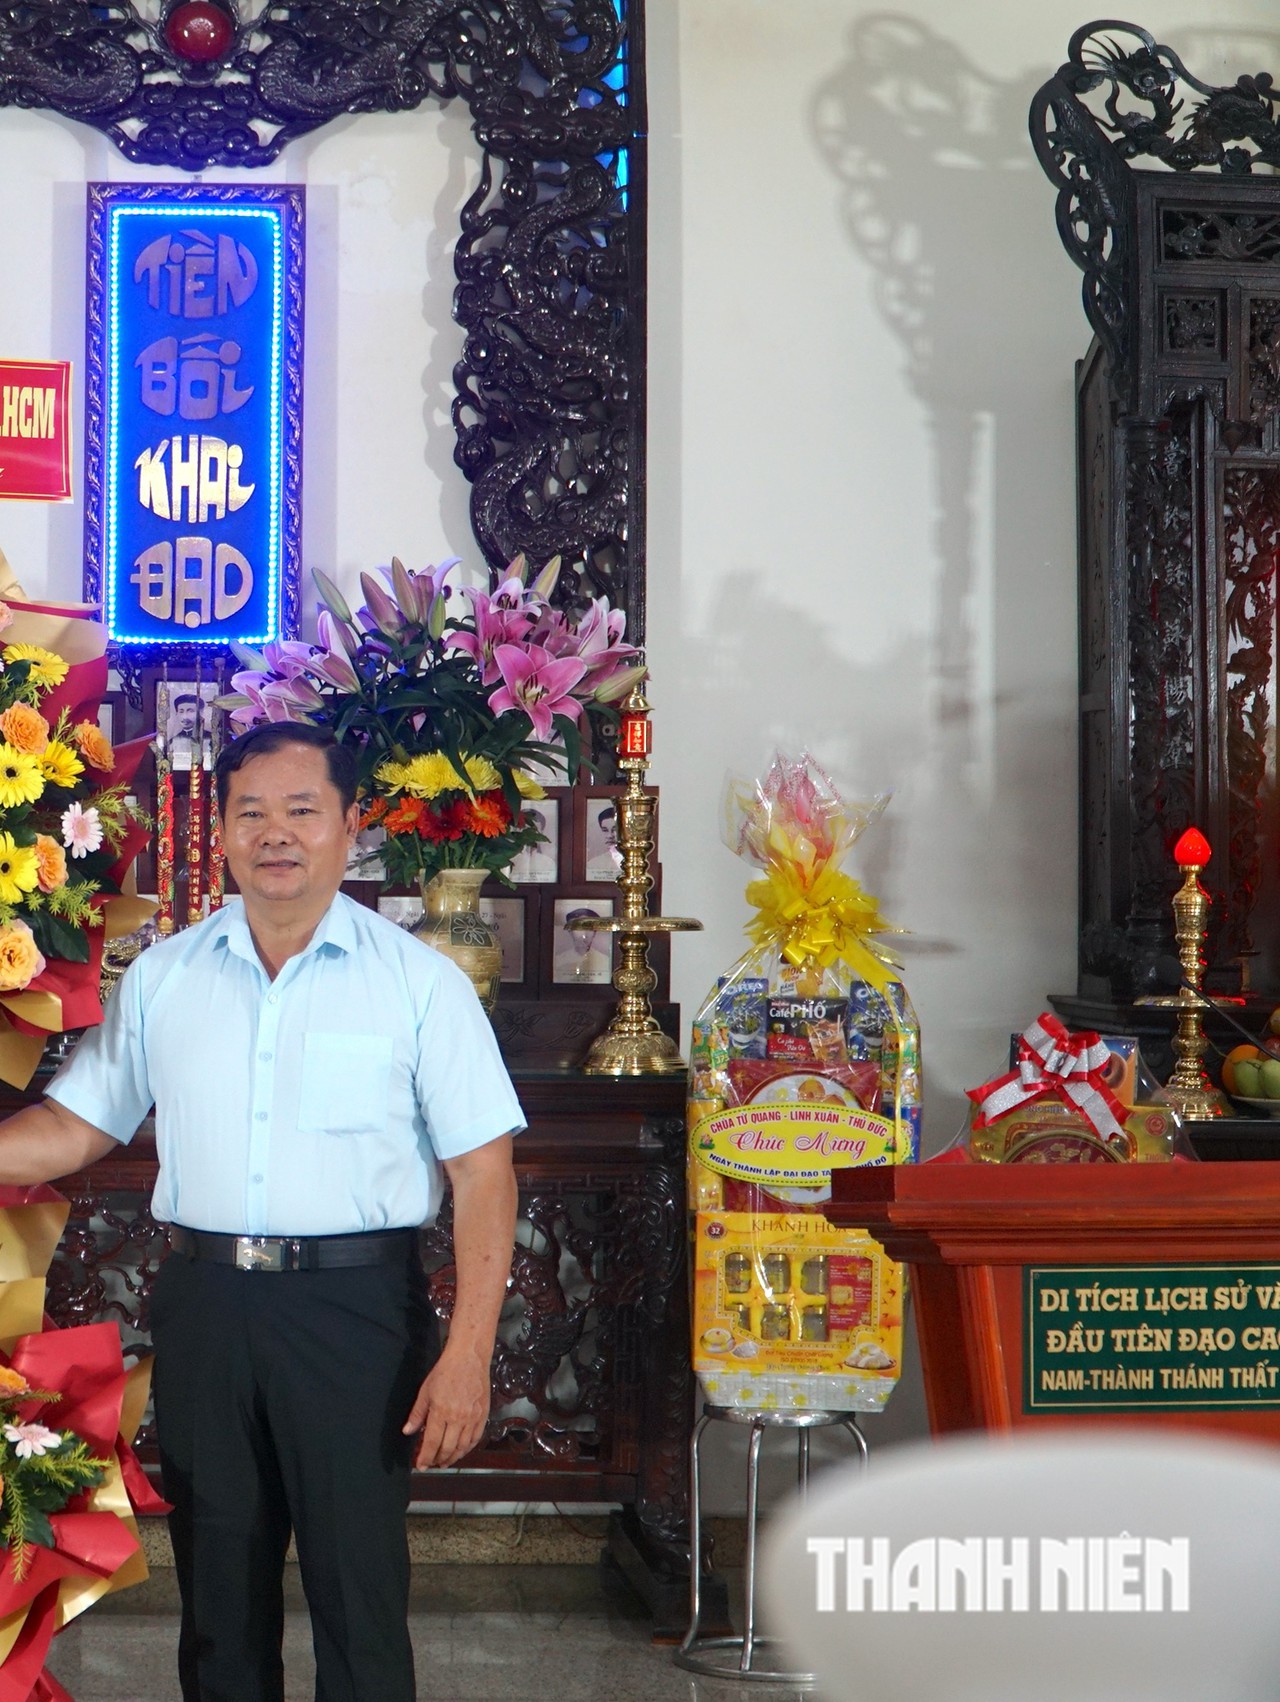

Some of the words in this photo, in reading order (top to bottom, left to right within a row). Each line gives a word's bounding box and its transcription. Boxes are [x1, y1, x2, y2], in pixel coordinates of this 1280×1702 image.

[130, 536, 254, 628] ĐẠO
[751, 1111, 781, 1124] QUANG
[790, 1111, 811, 1121] LINH
[814, 1110, 839, 1124] XUÂN
[849, 1114, 867, 1130] THỦ
[868, 1121, 888, 1138] ĐỨC
[729, 1130, 785, 1151] Chúc
[794, 1130, 867, 1160] Mừng
[710, 1227, 720, 1235] 32
[1040, 1288, 1070, 1312] DI
[1075, 1282, 1139, 1312] TÍCH
[1145, 1287, 1208, 1316] LỊCH
[1214, 1278, 1252, 1311] SỬ
[1046, 1321, 1105, 1353] ĐẦU
[1111, 1322, 1173, 1352] TIÊN
[1178, 1327, 1237, 1357] ĐẠO
[1041, 1364, 1154, 1391] NAM-THÀNH
[1160, 1363, 1224, 1389] THÁNH
[1229, 1359, 1279, 1389] THẤT
